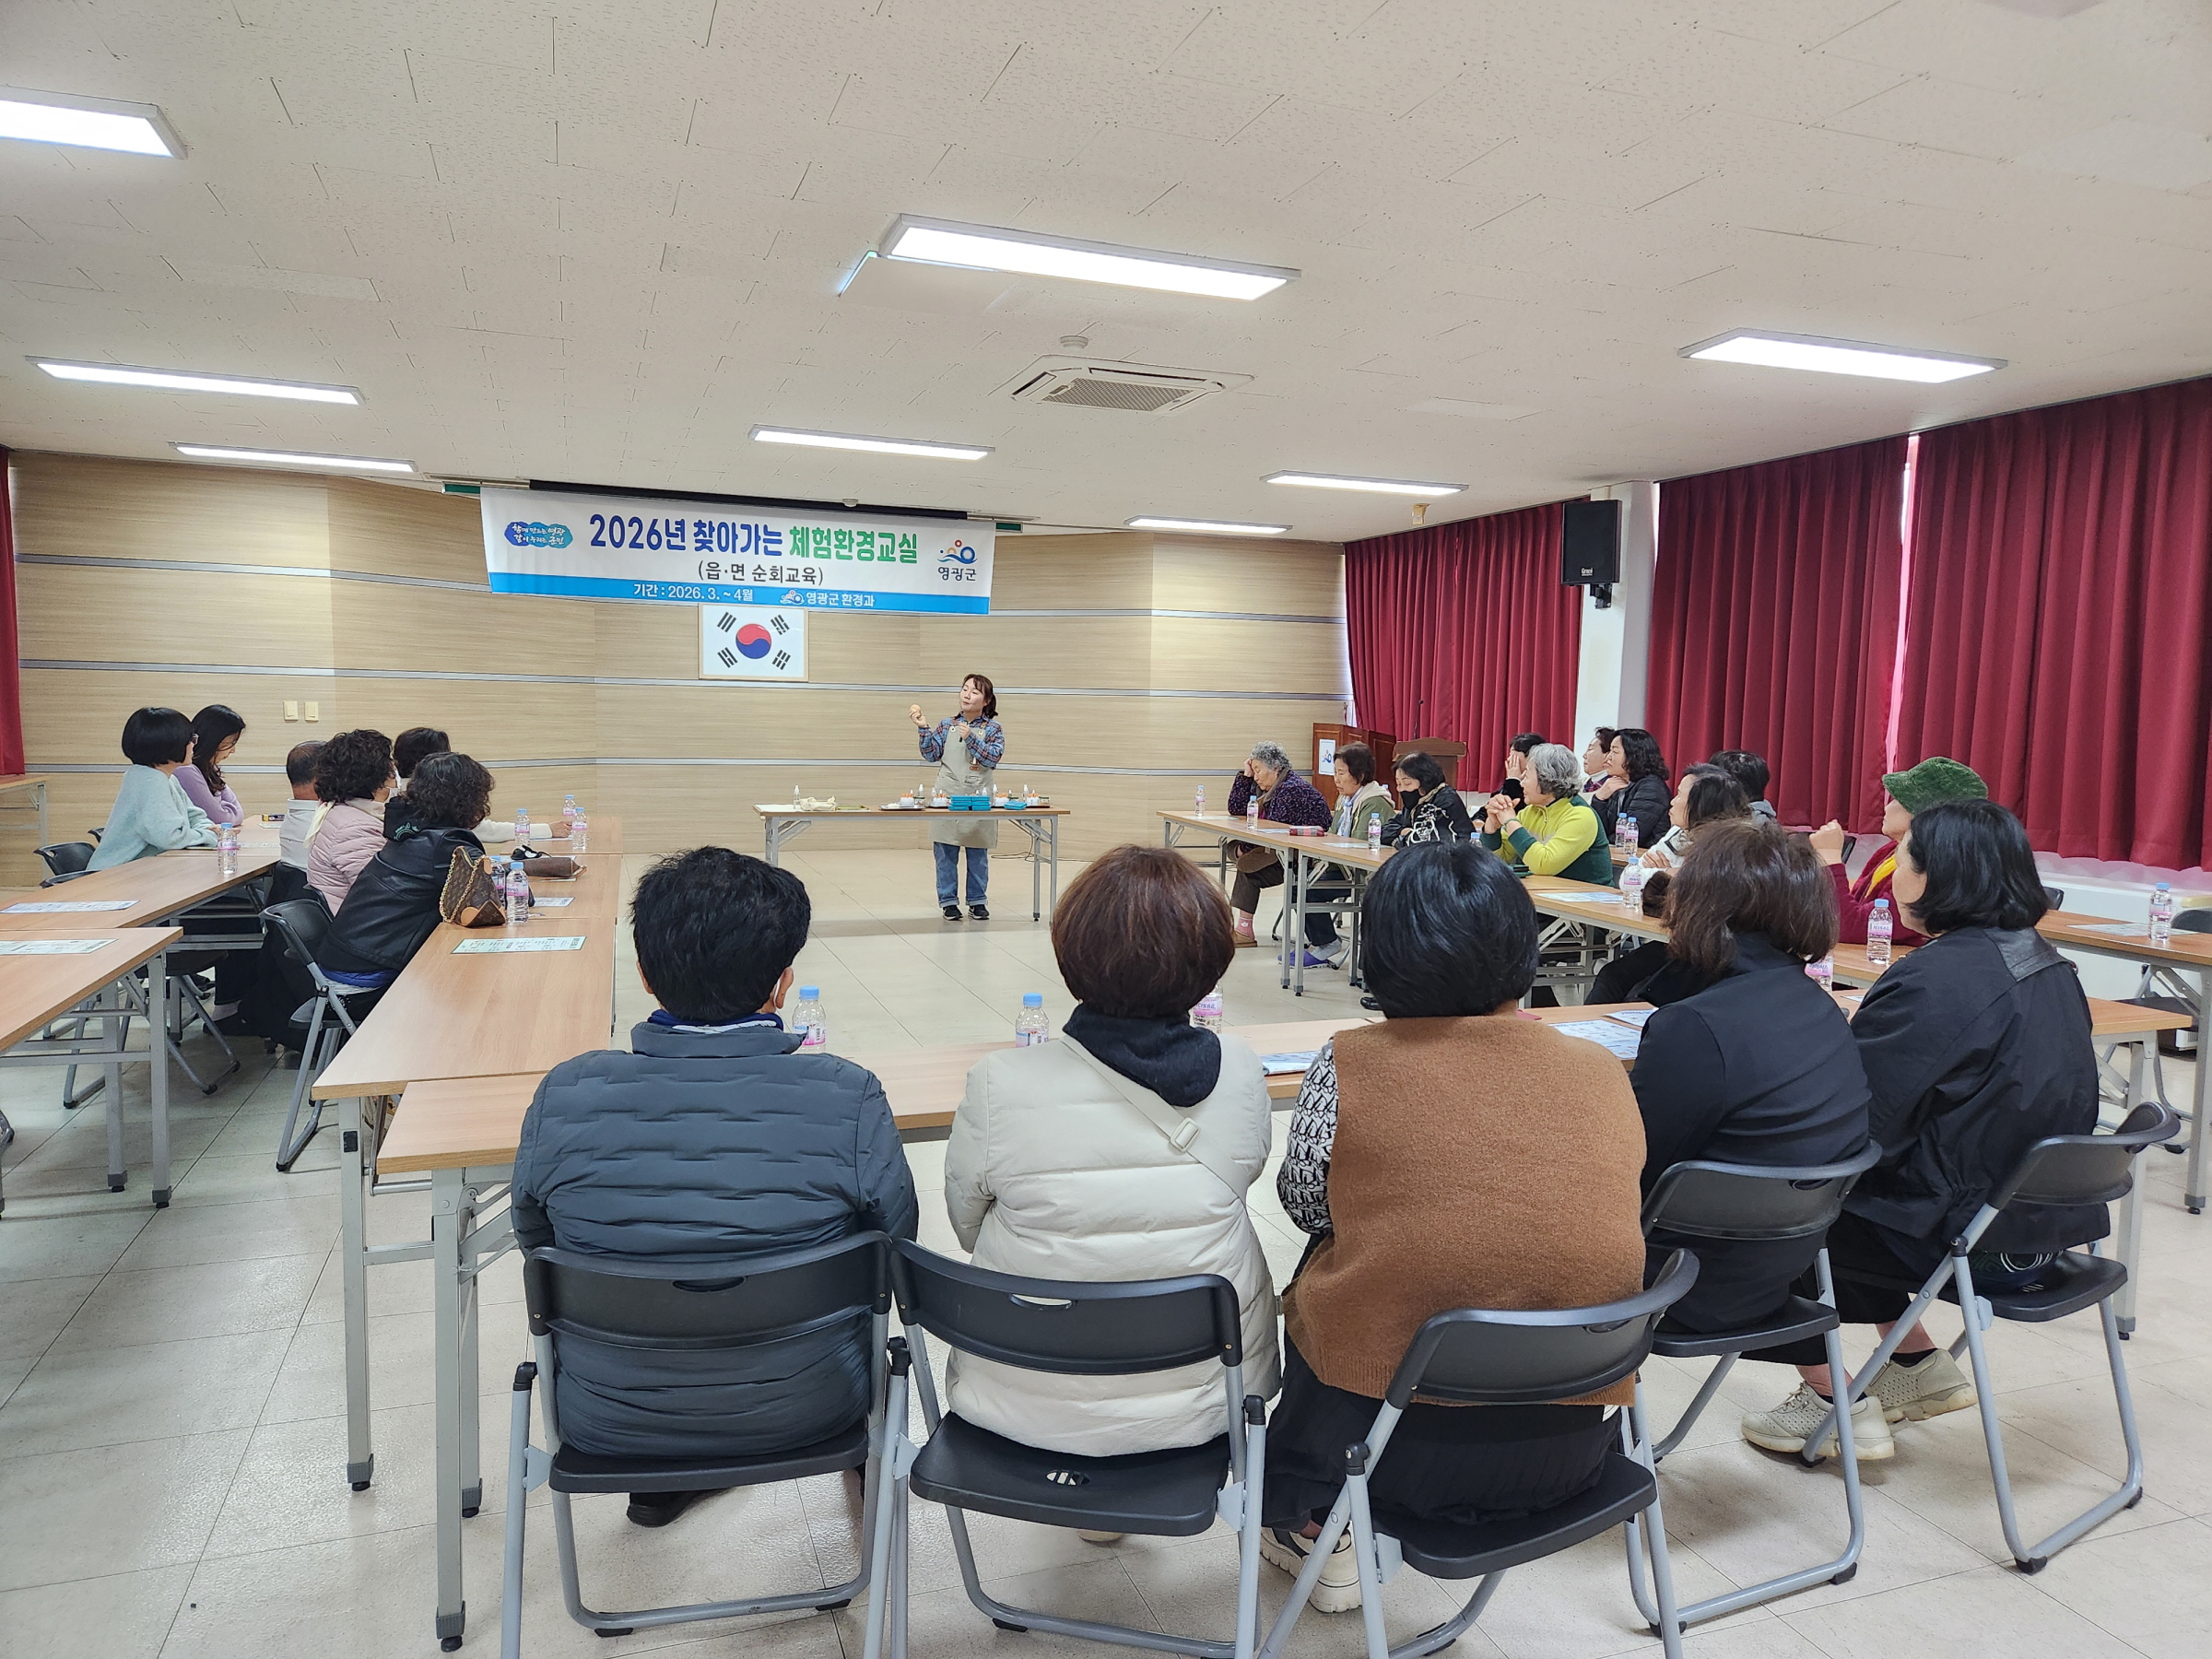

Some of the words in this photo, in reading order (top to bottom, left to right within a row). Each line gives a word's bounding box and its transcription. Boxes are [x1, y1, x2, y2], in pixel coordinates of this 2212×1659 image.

[512, 524, 529, 534] 함께
[547, 527, 565, 536] 영광
[513, 534, 529, 544] 같이
[548, 535, 564, 546] 군민
[589, 513, 687, 551] 2026년
[693, 519, 782, 557] 찾아가는
[789, 525, 918, 564] 체험환경교실
[698, 560, 745, 582] (읍·면
[751, 565, 824, 586] 순회교육)
[937, 566, 977, 582] 영광군
[806, 592, 840, 606] 영광군
[841, 593, 875, 607] 환경과
